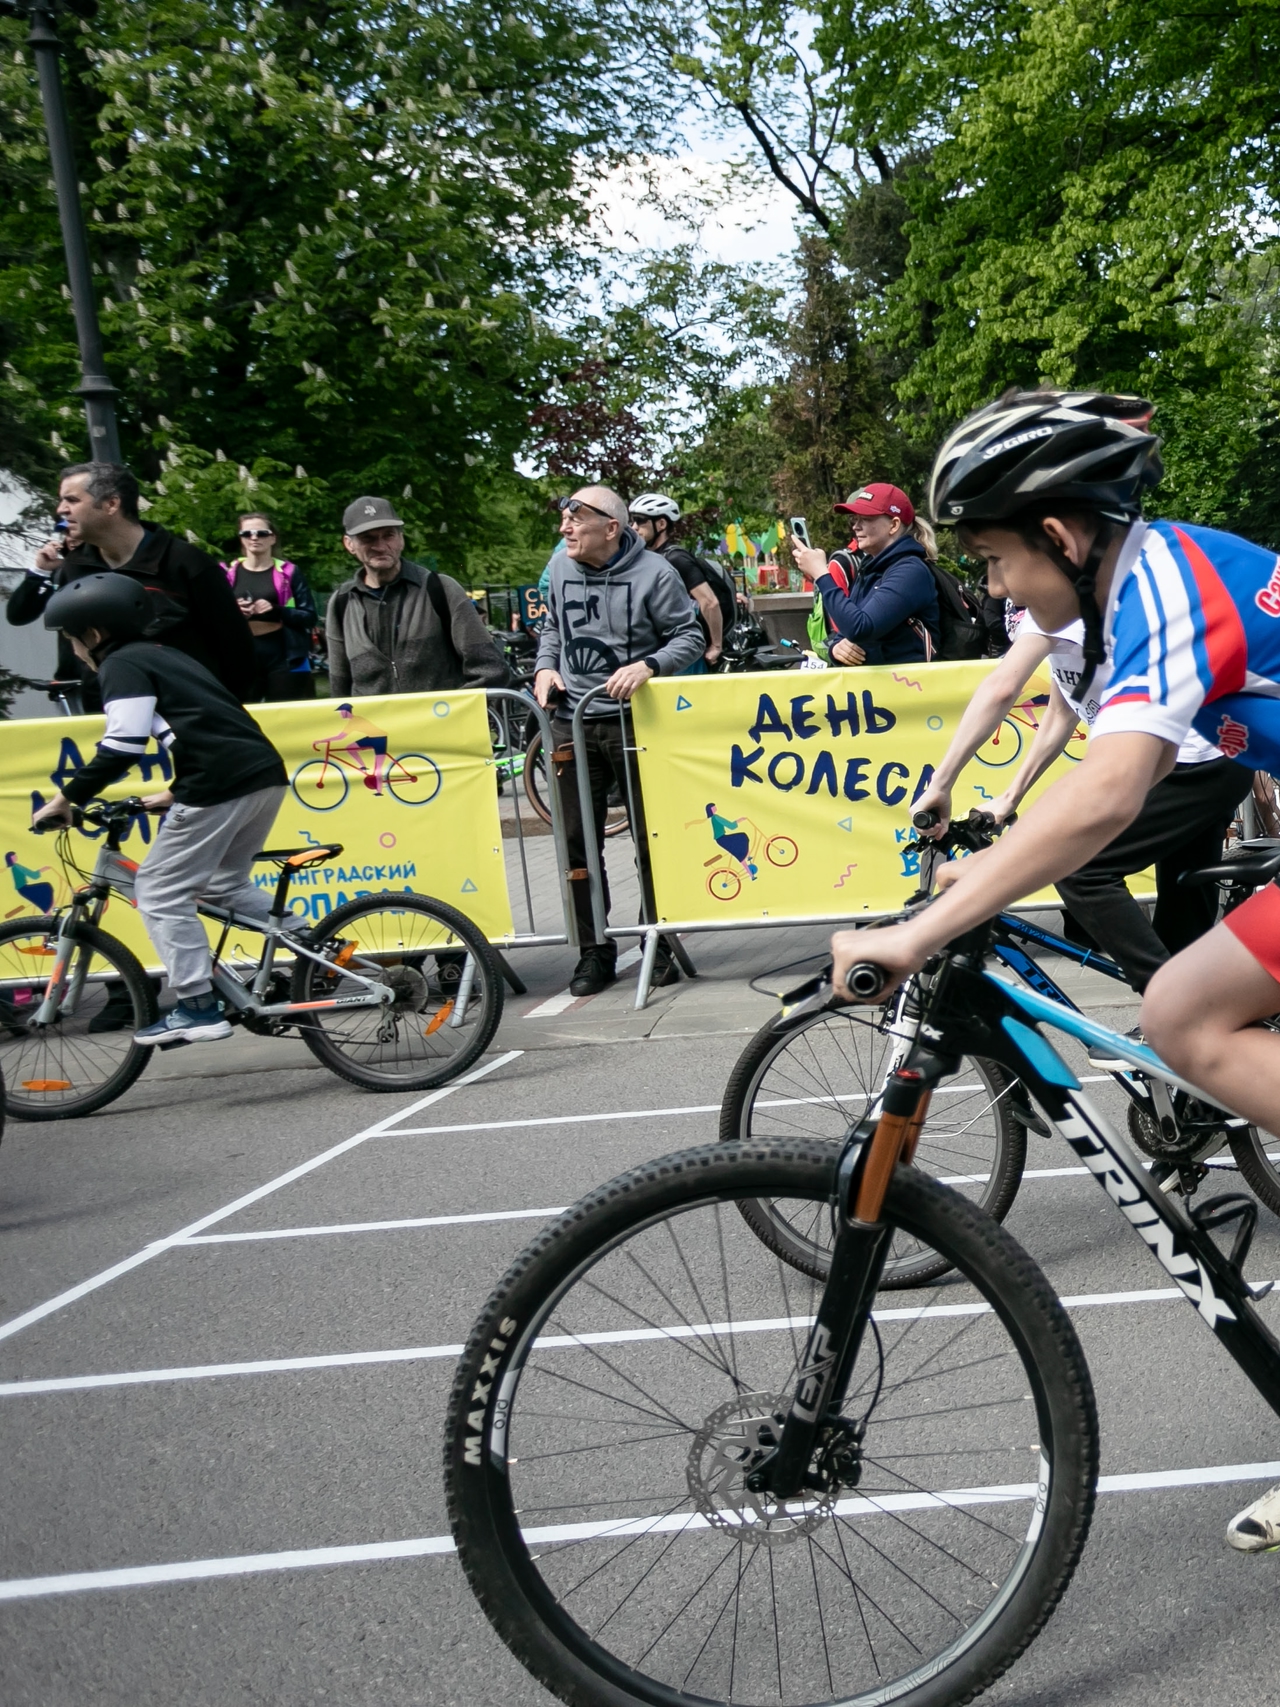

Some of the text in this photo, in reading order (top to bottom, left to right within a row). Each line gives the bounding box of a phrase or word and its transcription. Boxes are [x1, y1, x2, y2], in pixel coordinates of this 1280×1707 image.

[748, 689, 897, 744] ДЕНЬ
[731, 743, 935, 807] КОЛЕСА
[1054, 1102, 1237, 1330] TRINX
[463, 1315, 518, 1466] MAXXIS
